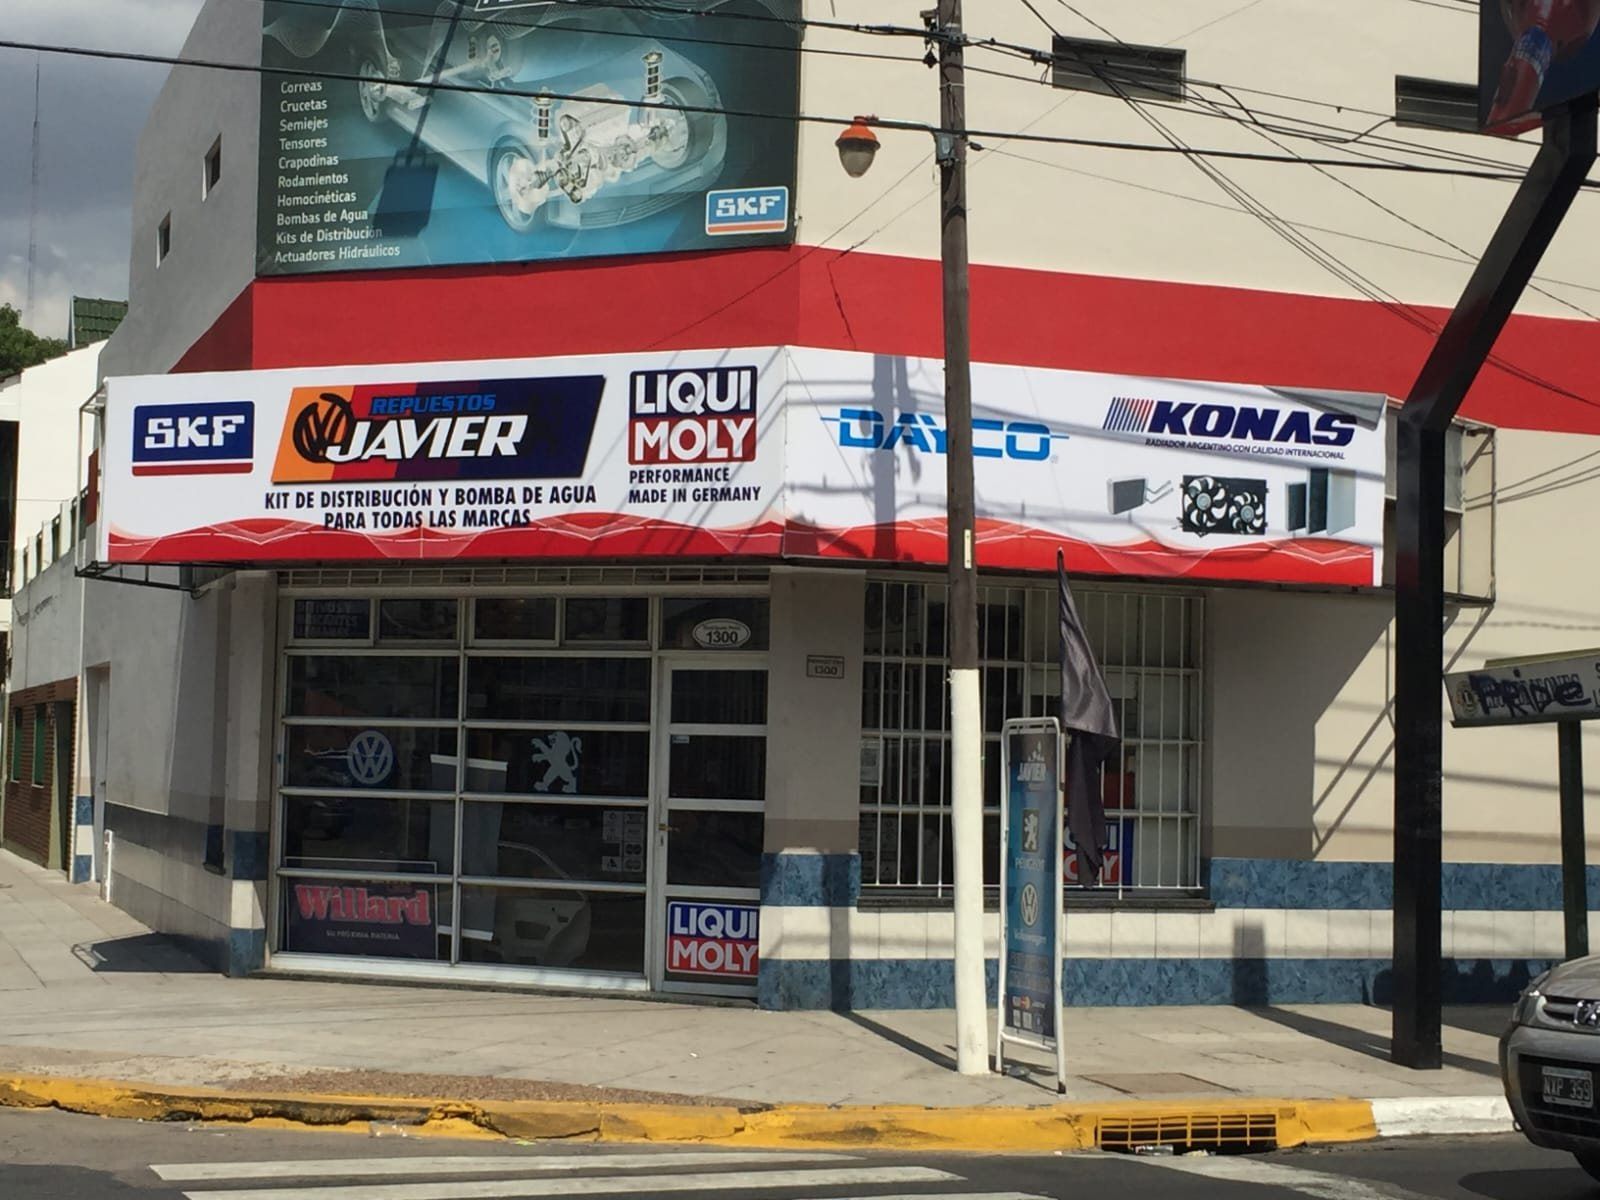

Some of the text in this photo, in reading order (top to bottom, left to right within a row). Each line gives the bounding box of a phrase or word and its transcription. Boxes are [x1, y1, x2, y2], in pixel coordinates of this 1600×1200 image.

[280, 81, 323, 94] Correas
[280, 99, 328, 113] Crucetas
[279, 116, 329, 132] Semiejes
[278, 136, 328, 151] Tensores
[278, 154, 339, 171] Crapodinas
[277, 172, 349, 188] Rodamientos
[276, 190, 357, 207] Homocinéticas
[715, 195, 781, 217] SKF
[276, 208, 368, 226] Bombas de Agua
[275, 231, 297, 245] Kits
[300, 229, 313, 243] de
[274, 243, 401, 264] Actuadores Hidráulicos
[634, 370, 750, 415] LIQUI
[371, 393, 496, 415] REPUESTOS
[144, 414, 246, 449] SKF
[1148, 400, 1358, 447] KONAS
[325, 414, 528, 463] JAVIER
[633, 417, 755, 461] MOLY
[1145, 438, 1345, 460] RADIADOR ARGENTINO CON CALIDAD INTERNACIONAL
[629, 467, 730, 484] PERFORMANCE
[265, 484, 597, 510] KIT DE DISTRIBUCIÓN Y BOMBA DE AGUA
[628, 486, 761, 504] MADE IN GERMANY
[324, 508, 531, 530] PARA TODAS LAS MARCAS
[706, 630, 738, 644] 1300
[295, 884, 431, 926] Willard
[673, 907, 757, 939] LIQUI
[672, 939, 758, 972] MOLY
[1543, 1076, 1564, 1097] NXP
